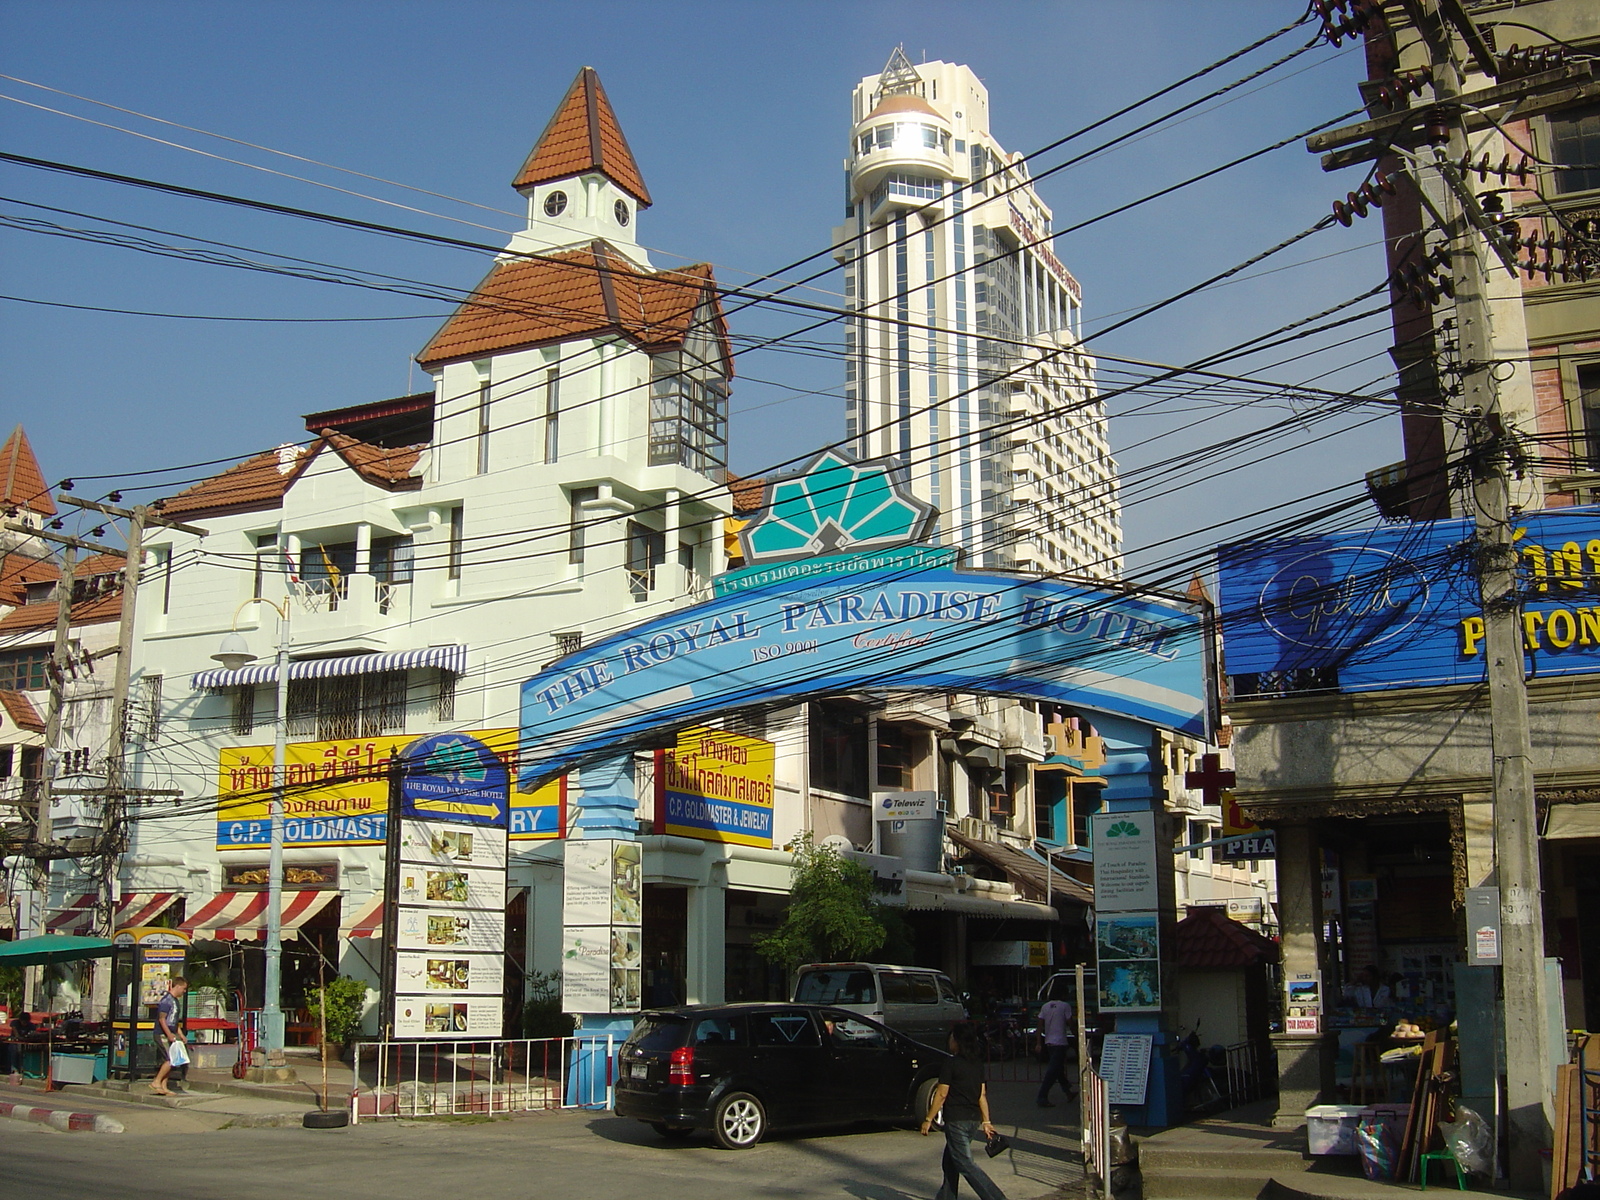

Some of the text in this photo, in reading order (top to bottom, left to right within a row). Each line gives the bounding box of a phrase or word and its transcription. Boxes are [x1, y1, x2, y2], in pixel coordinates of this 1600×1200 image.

[535, 590, 1181, 715] THE ROYAL PARADISE HOTEL
[753, 628, 935, 662] ISO 9001 Certified
[700, 731, 747, 765] ห้างทอง
[405, 782, 505, 800] THE ROYAL PARADISE HOTEL
[893, 799, 925, 808] Telewiz
[447, 803, 464, 813] IN
[669, 798, 683, 817] C.P.
[685, 801, 732, 823] GOLDMASTER
[740, 809, 770, 831] JEWELRY
[229, 821, 265, 843] C.P.
